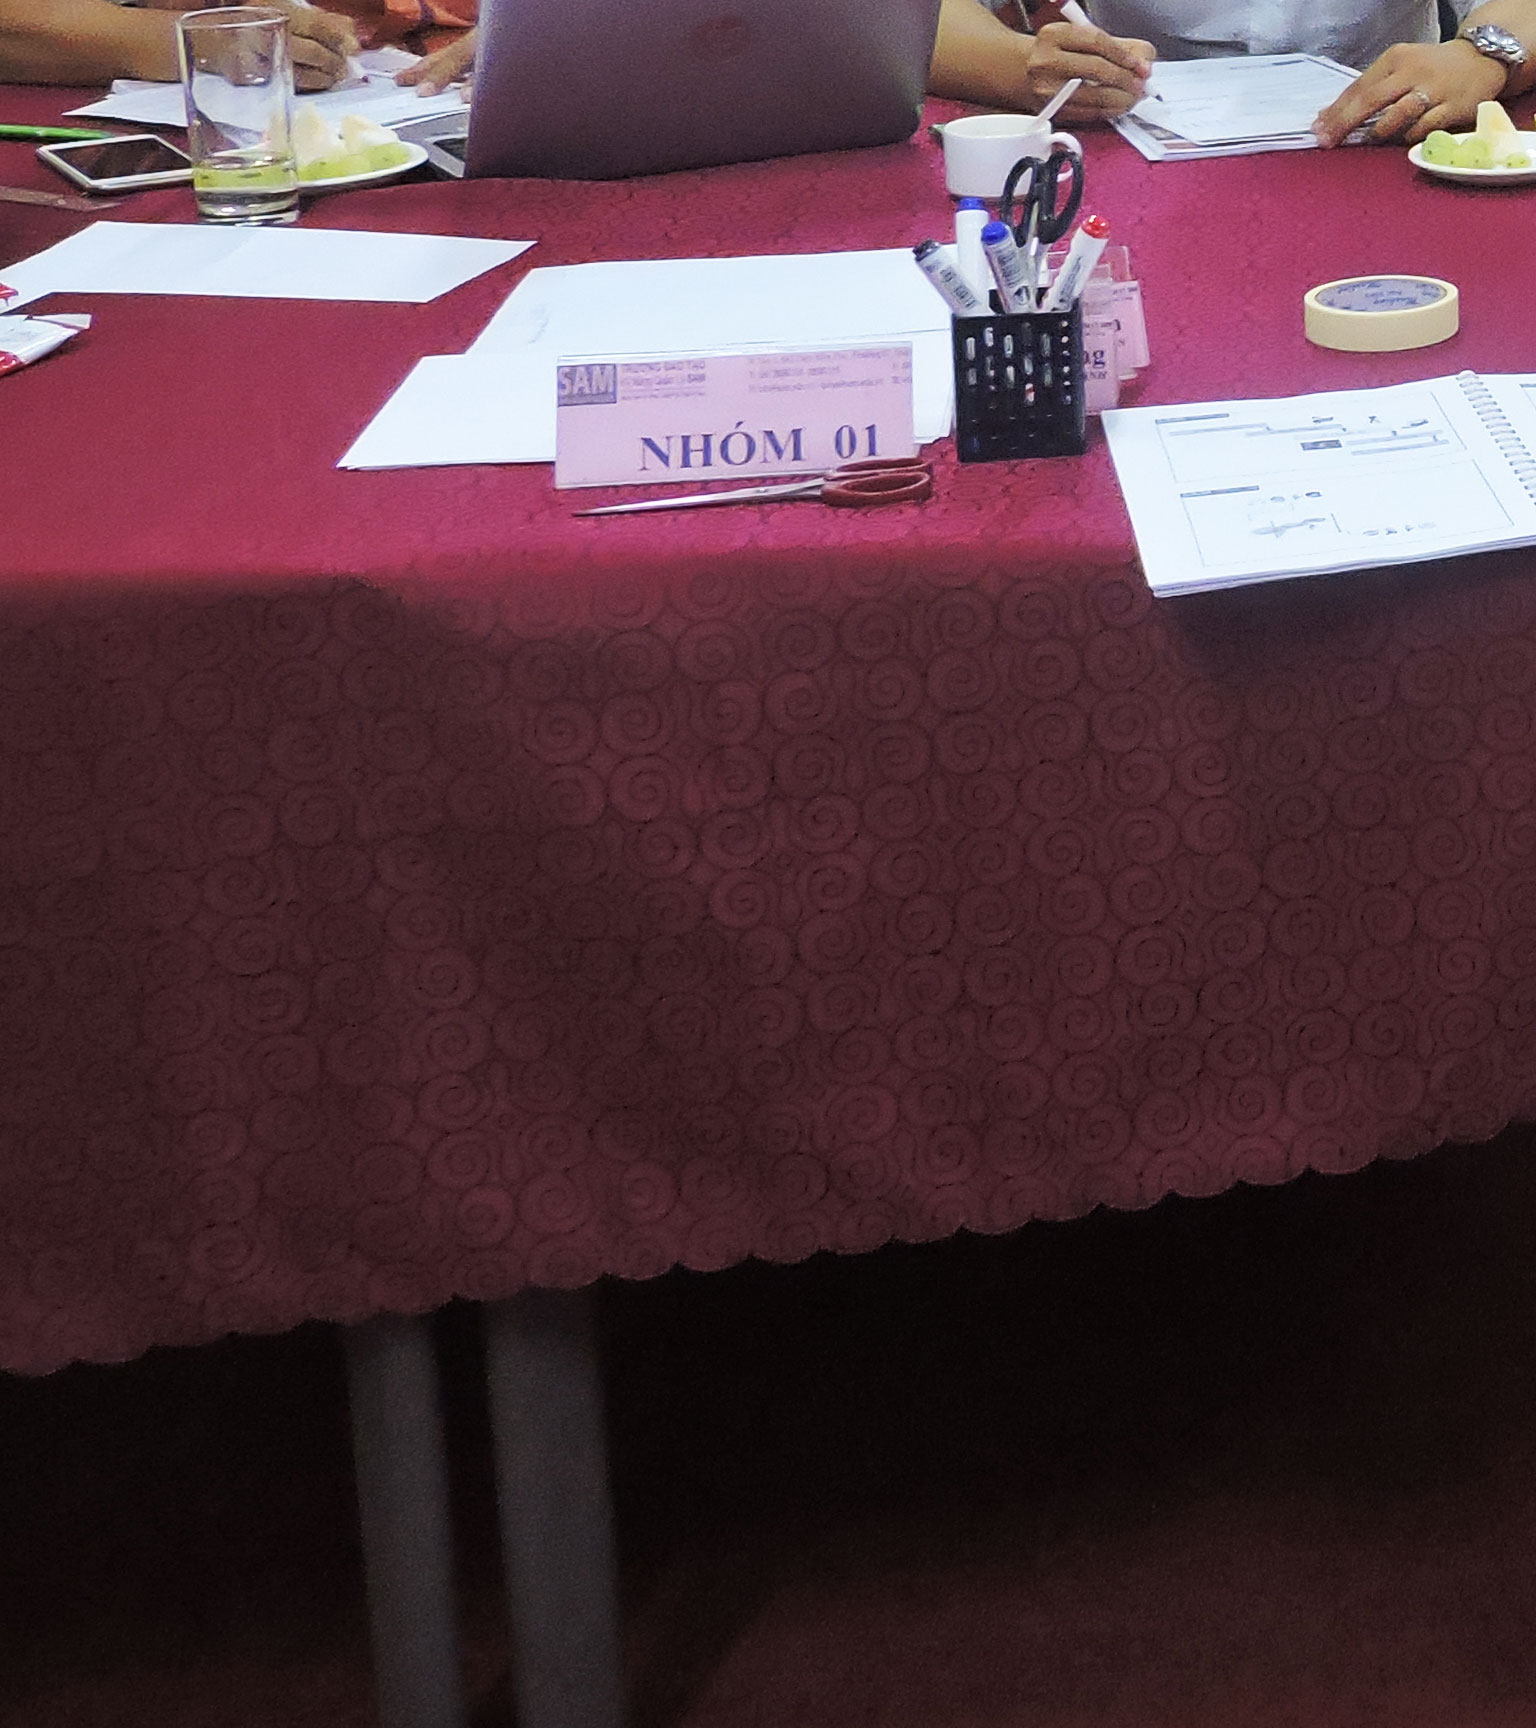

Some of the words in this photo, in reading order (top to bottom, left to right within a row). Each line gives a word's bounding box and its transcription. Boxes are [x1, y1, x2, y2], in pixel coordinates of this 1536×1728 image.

[557, 365, 614, 396] SAM
[639, 420, 807, 471] NHÓM
[834, 424, 881, 460] 01
